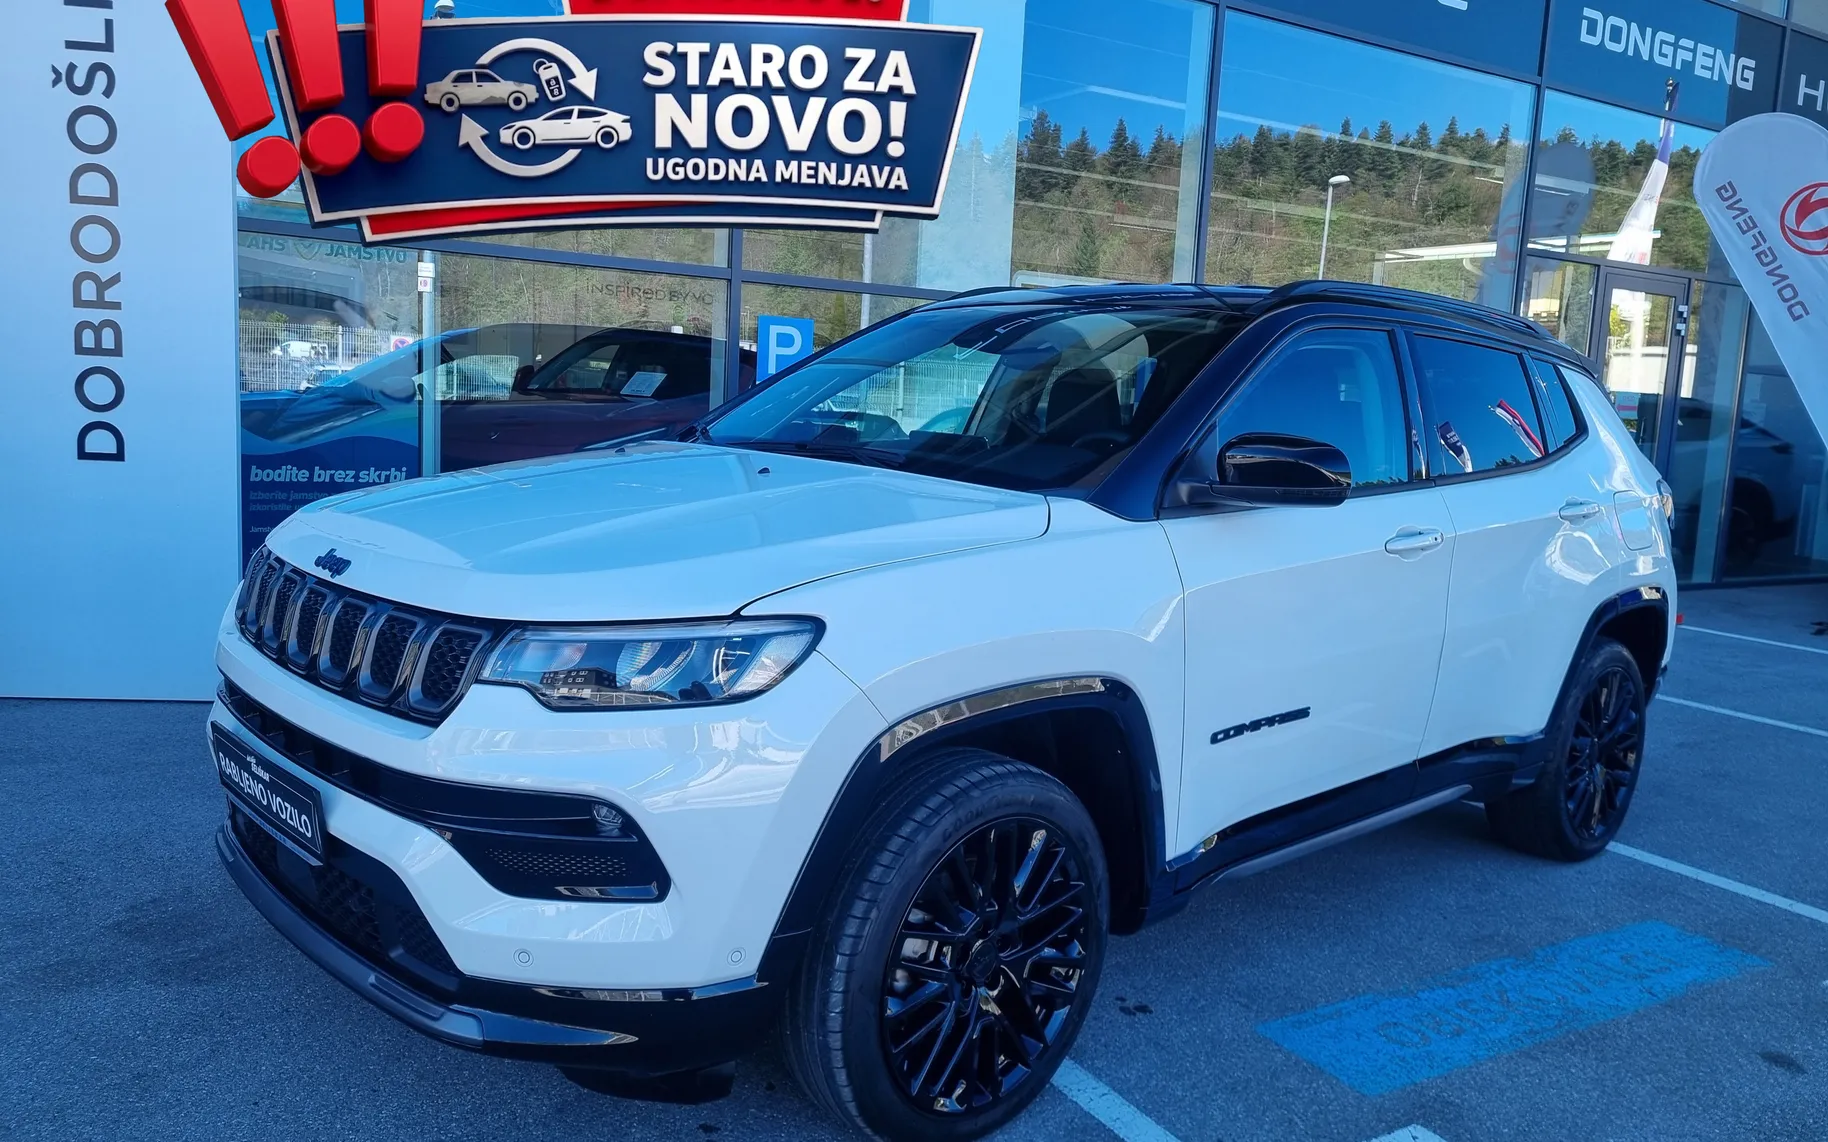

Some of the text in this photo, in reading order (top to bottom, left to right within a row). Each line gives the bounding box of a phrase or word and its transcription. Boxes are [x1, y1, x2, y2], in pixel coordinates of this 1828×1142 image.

[1579, 6, 1757, 91] DONGFENG
[1797, 73, 1828, 112] H
[247, 235, 408, 264] AHS JAMSTVO
[768, 325, 802, 374] P
[249, 464, 407, 484] bodite brez skrbi
[314, 548, 352, 579] Jeep
[1209, 706, 1311, 744] COMPASS
[219, 752, 268, 805] RABLJENO
[268, 790, 311, 838] VOZILO
